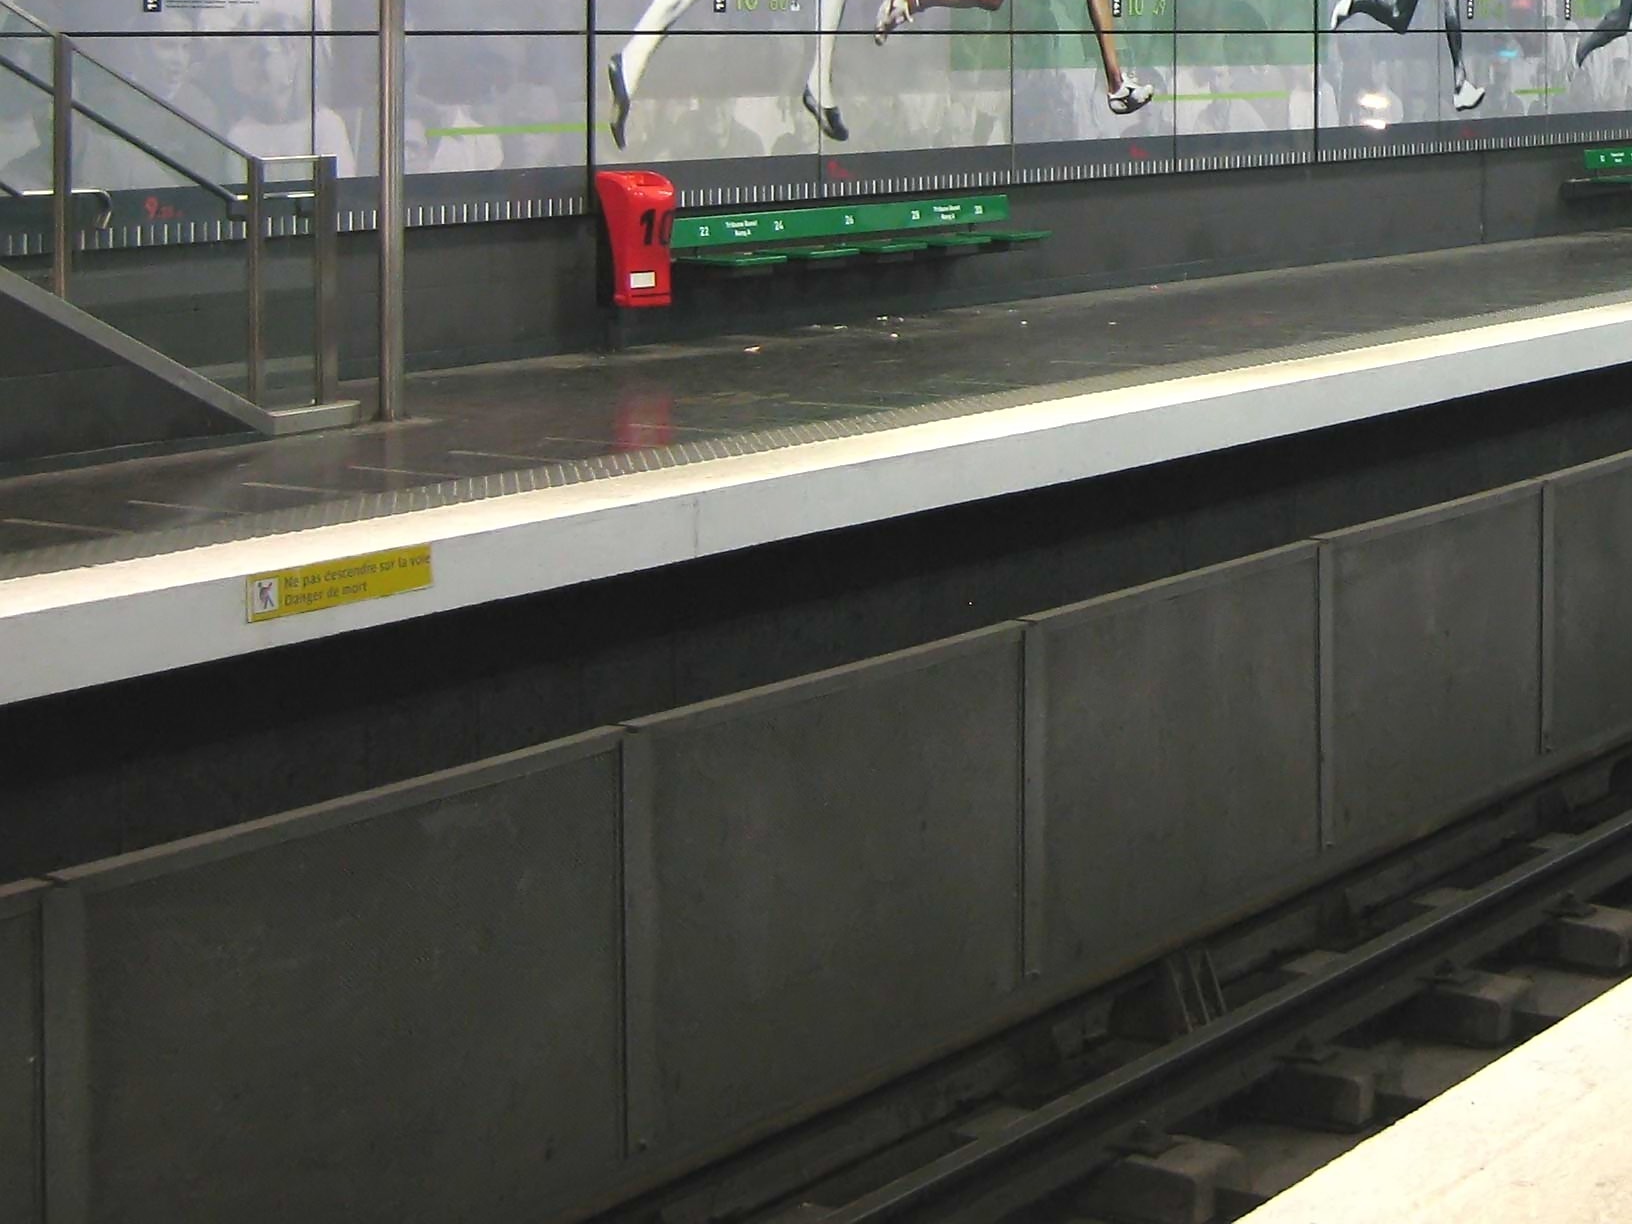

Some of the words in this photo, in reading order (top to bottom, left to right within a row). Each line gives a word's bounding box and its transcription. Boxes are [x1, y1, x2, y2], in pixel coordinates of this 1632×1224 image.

[699, 226, 710, 237] 22
[302, 573, 322, 588] pas
[398, 556, 408, 568] la
[284, 590, 323, 607] Danger
[342, 581, 368, 595] mort
